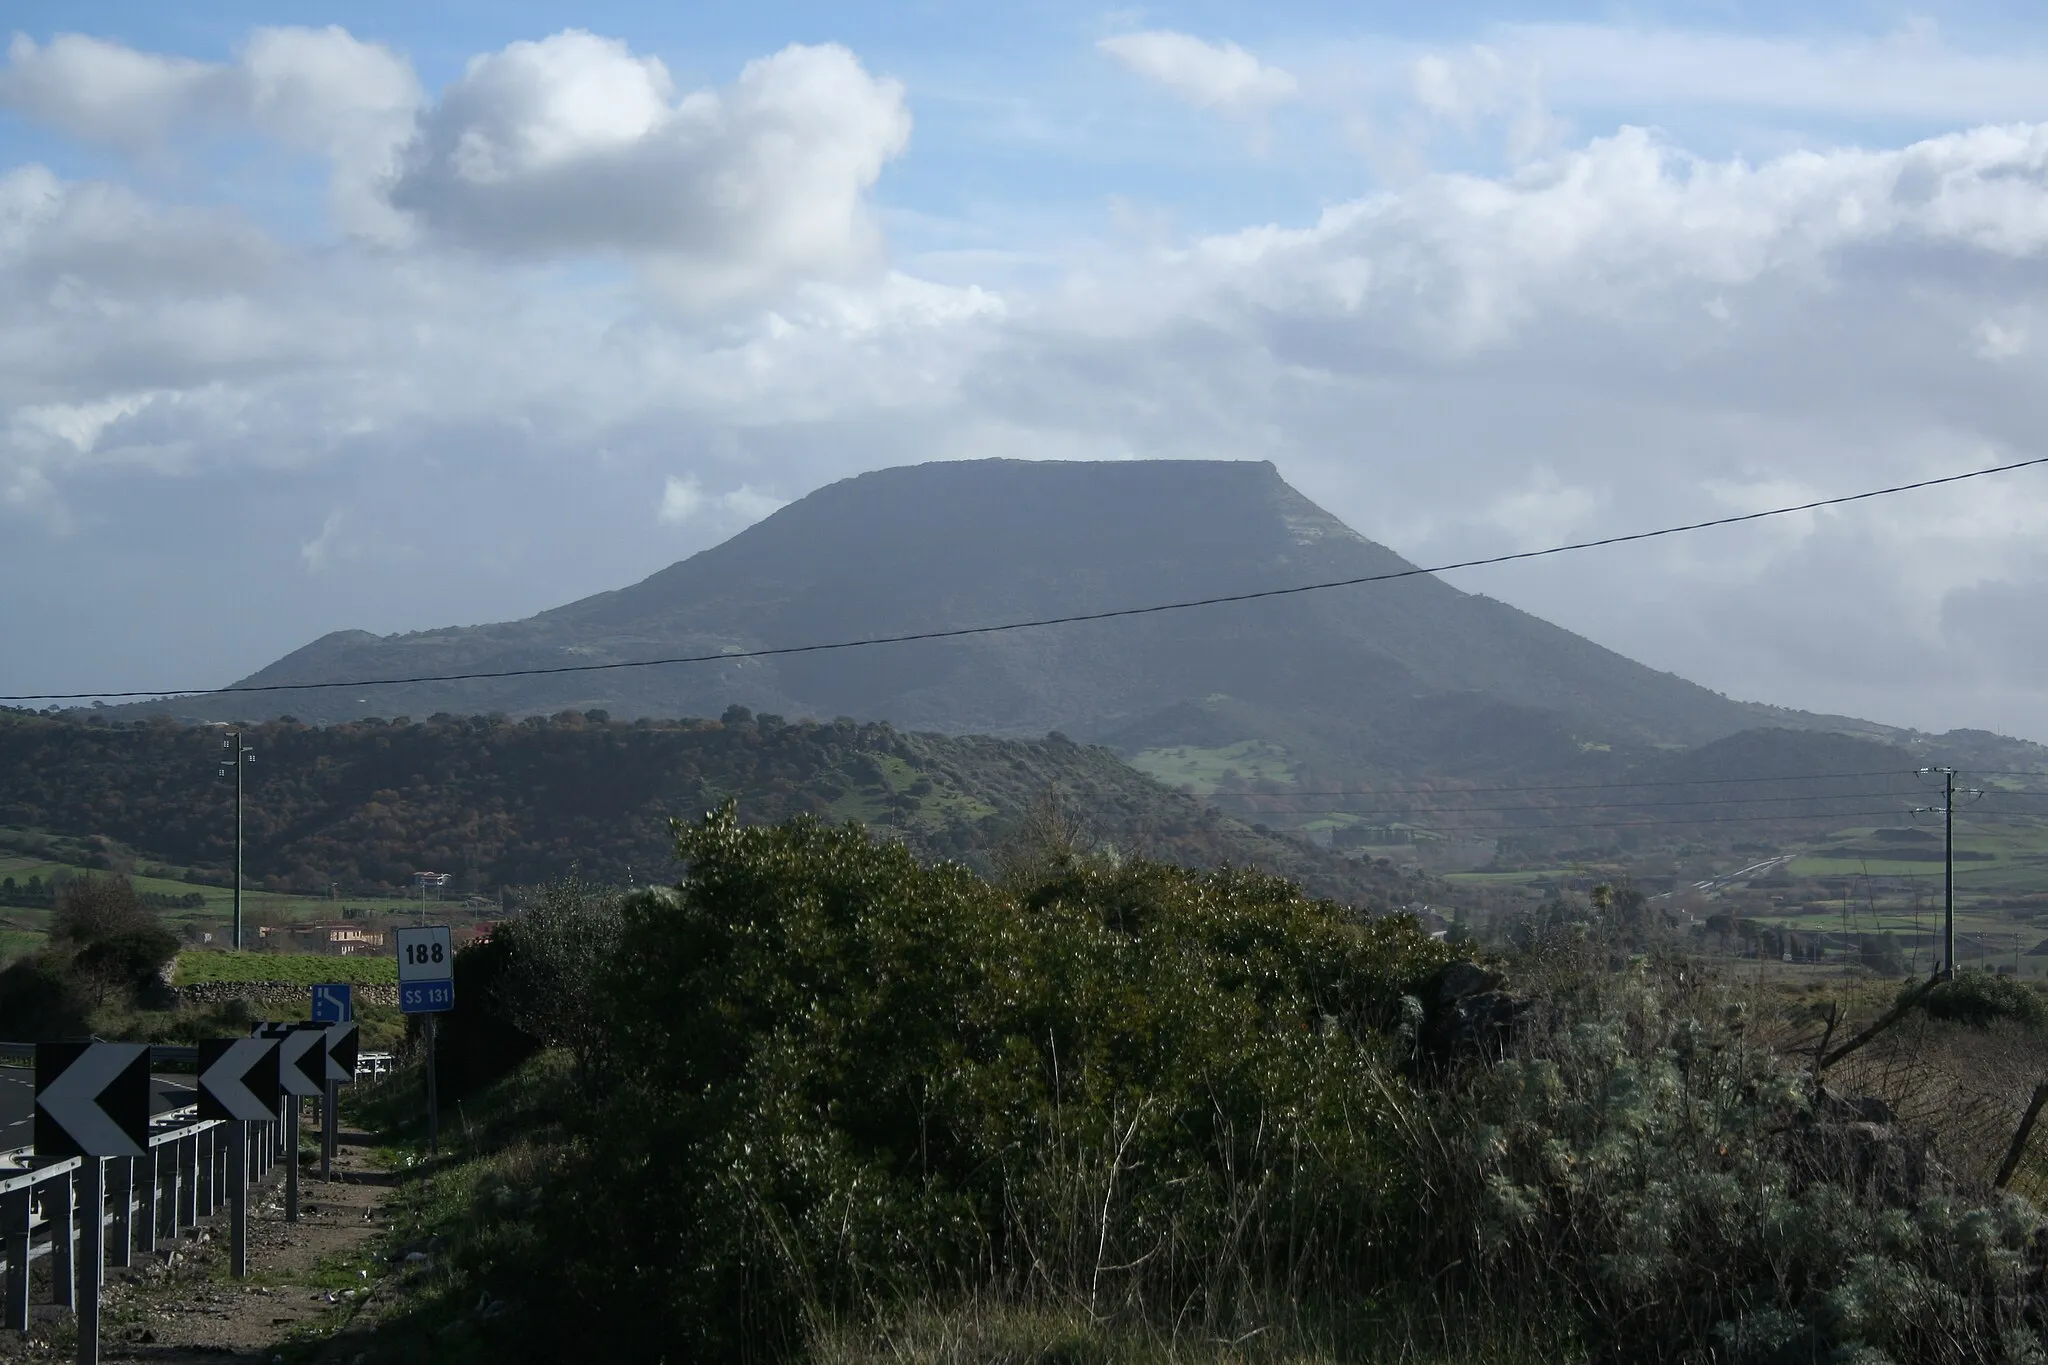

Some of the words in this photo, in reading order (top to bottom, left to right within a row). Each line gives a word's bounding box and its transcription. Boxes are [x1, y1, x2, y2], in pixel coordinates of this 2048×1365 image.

[406, 943, 443, 965] 188
[405, 990, 422, 1004] SS
[428, 989, 449, 1003] 131
